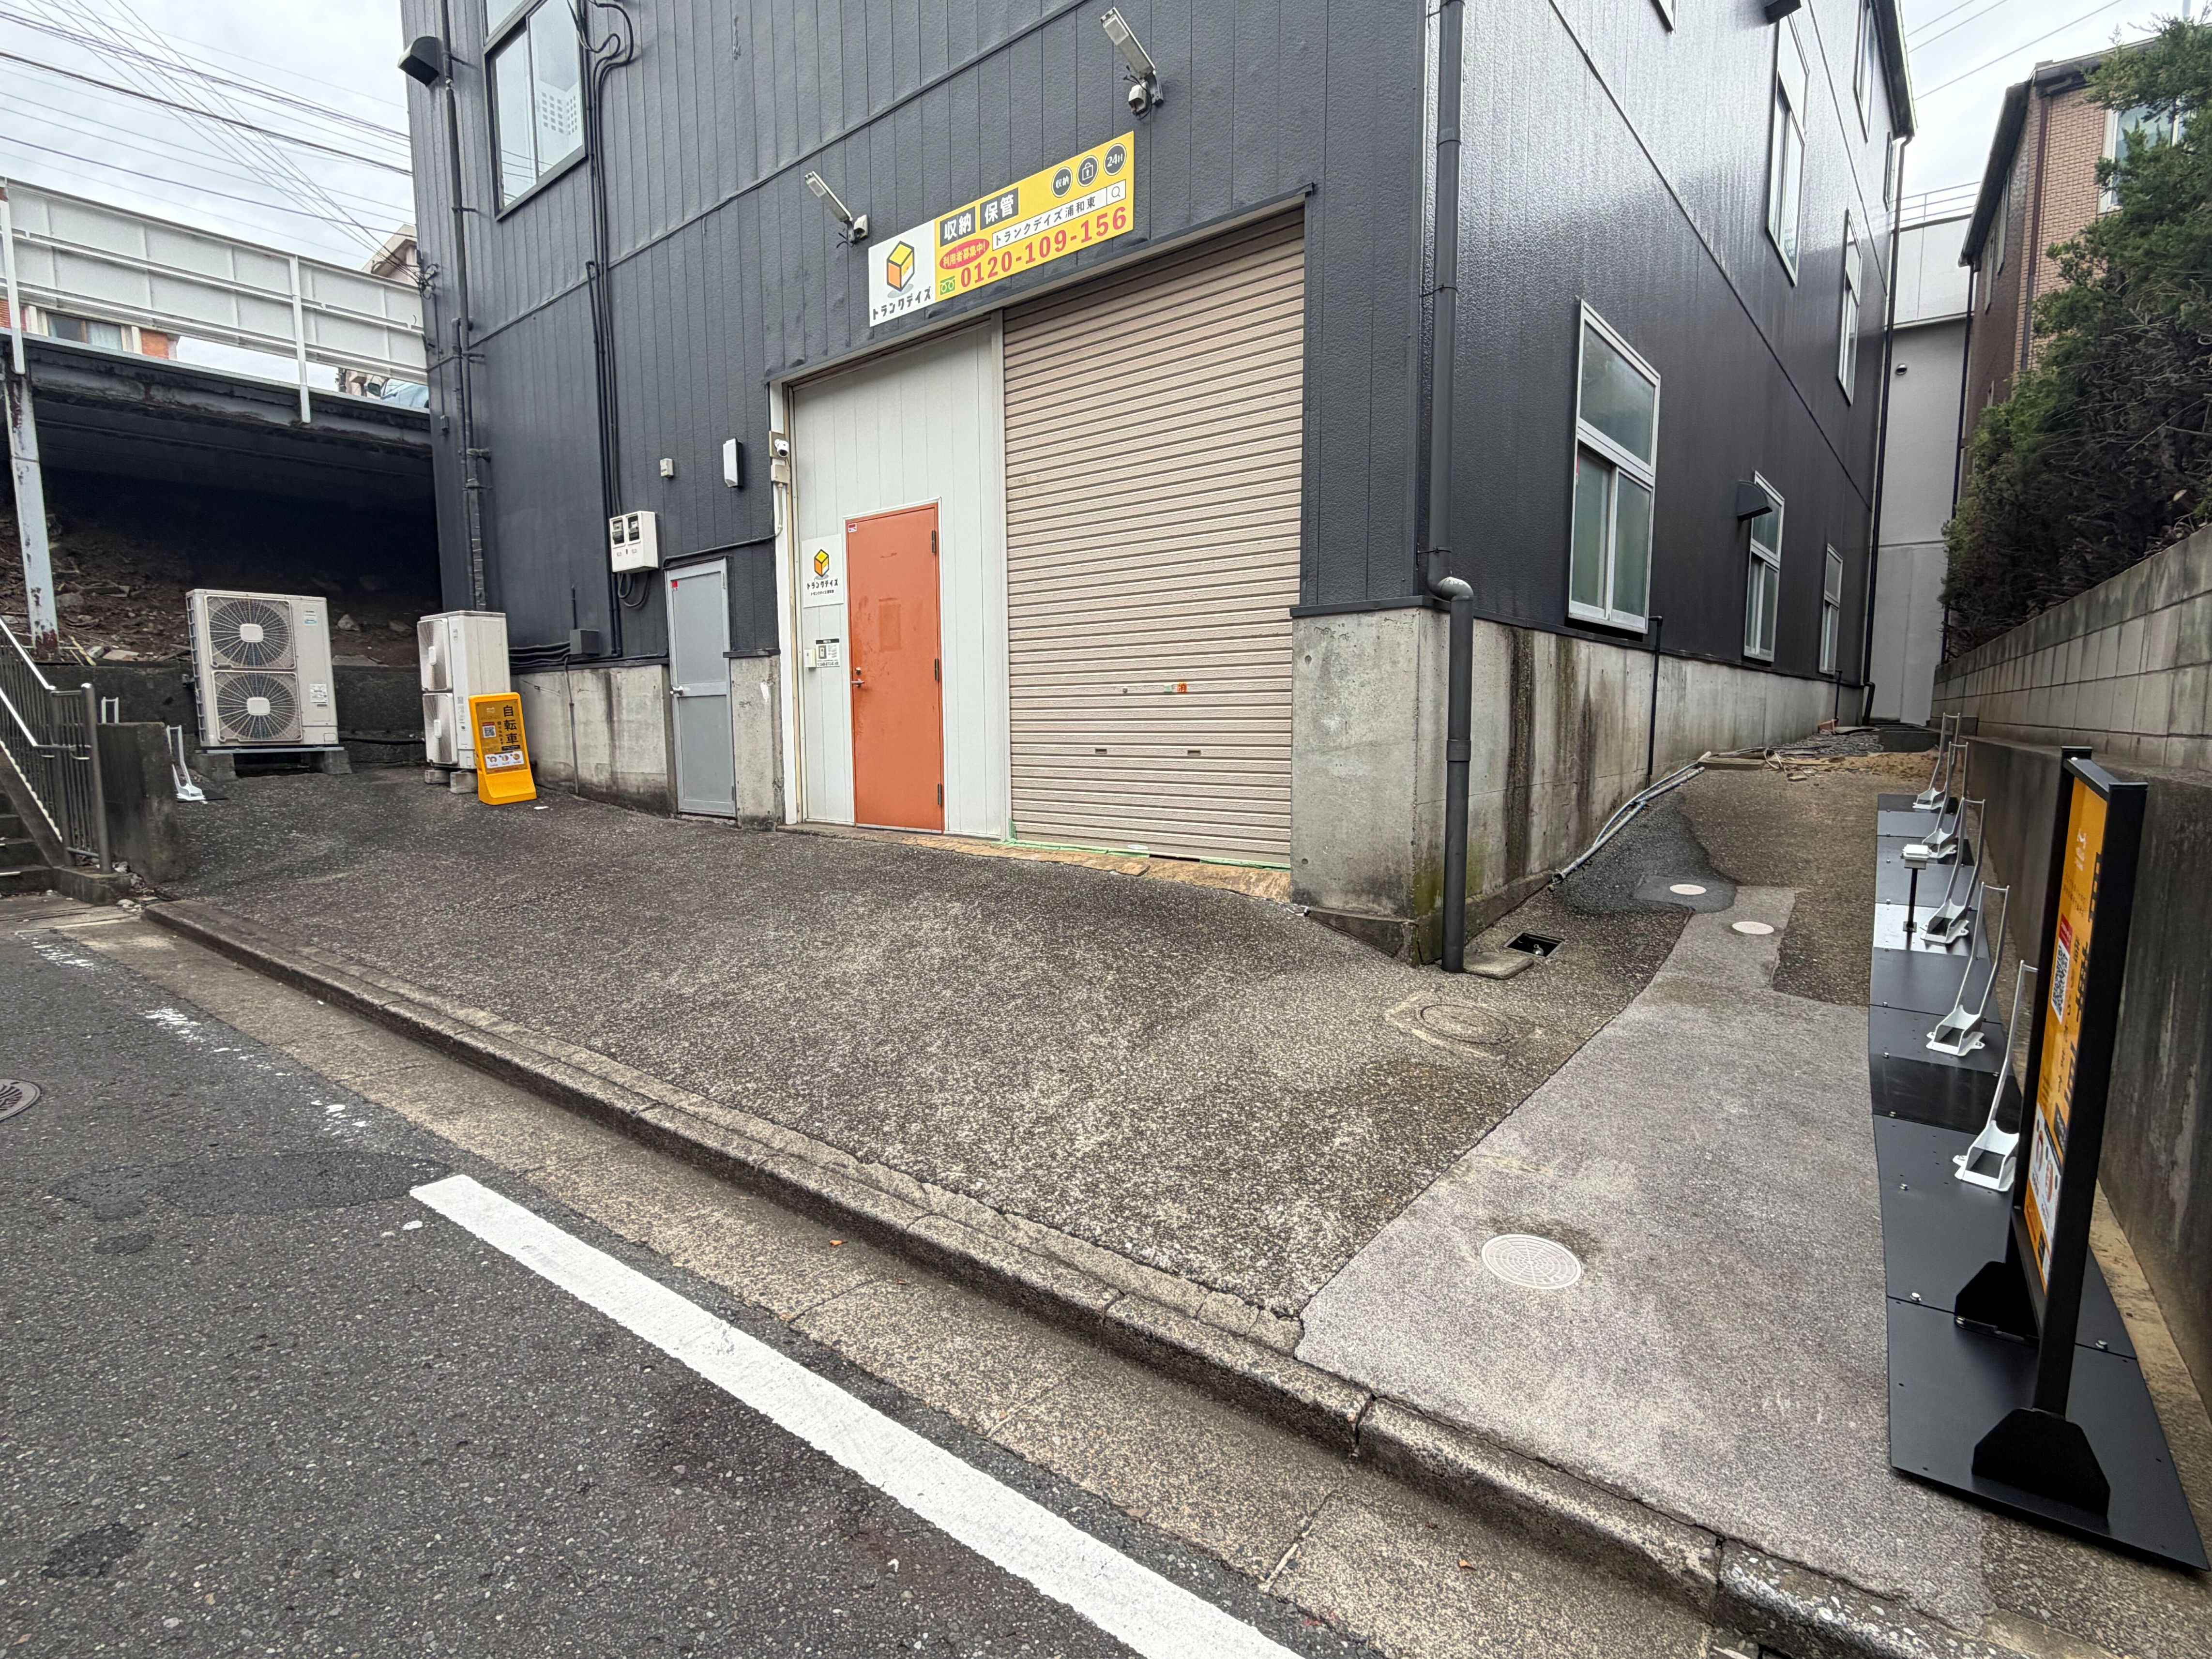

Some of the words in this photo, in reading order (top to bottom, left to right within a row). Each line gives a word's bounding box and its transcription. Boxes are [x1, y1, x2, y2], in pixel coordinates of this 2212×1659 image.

[985, 194, 1014, 225] 保管
[944, 212, 971, 241] 収納
[961, 206, 1126, 287] 0120-109-156
[873, 286, 931, 320] トランクデイズ
[807, 578, 838, 590] トランクデイズ
[503, 705, 519, 744] 自転車
